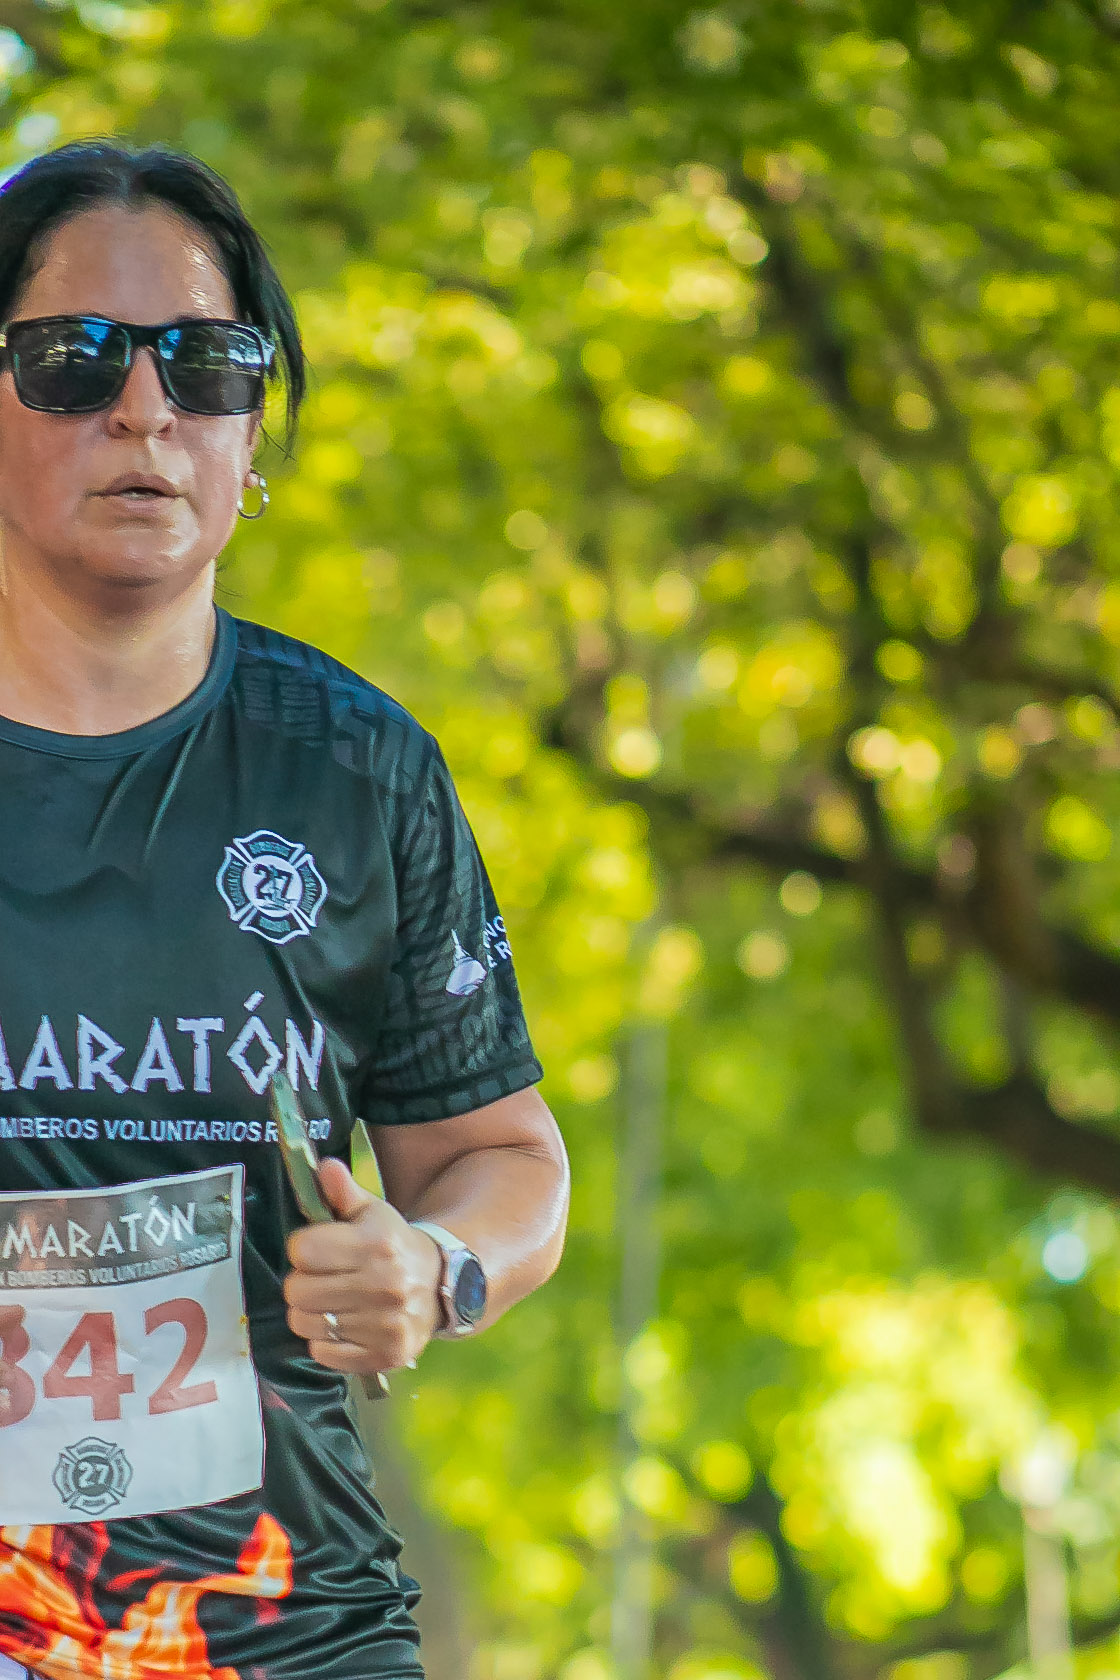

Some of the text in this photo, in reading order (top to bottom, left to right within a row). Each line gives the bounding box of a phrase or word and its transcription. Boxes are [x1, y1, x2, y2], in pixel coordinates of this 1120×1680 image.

[254, 863, 294, 900] 27
[102, 1118, 262, 1143] VOLUNTARIOS
[1, 1194, 196, 1260] MARATÓN
[79, 1461, 110, 1489] 27
